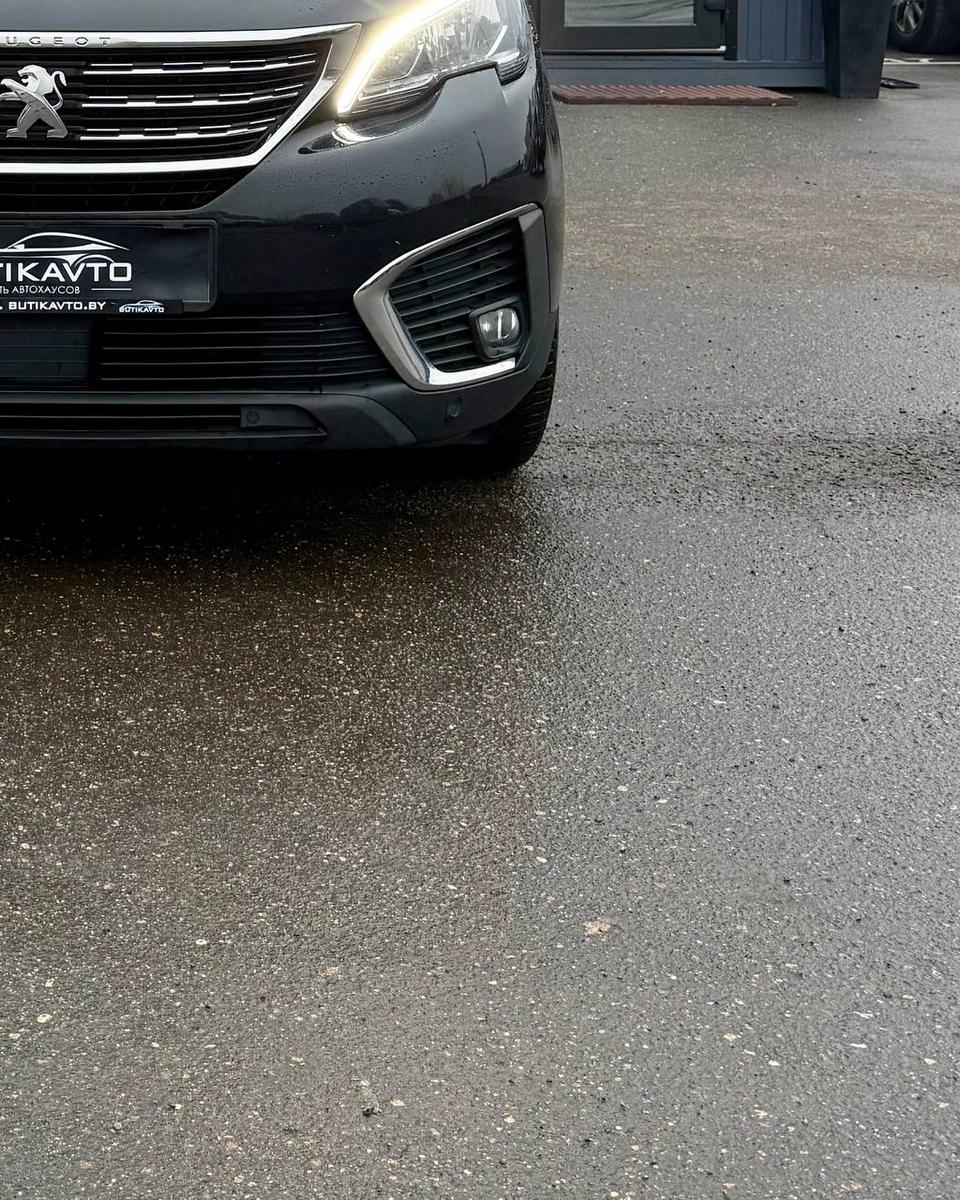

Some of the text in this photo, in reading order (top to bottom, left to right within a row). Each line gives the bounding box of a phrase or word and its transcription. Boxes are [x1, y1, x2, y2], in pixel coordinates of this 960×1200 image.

[11, 285, 81, 295] АВТОХАУСОВ
[8, 301, 107, 311] BUTIKAVTO.BY
[119, 305, 165, 313] BUTIKAVTO
